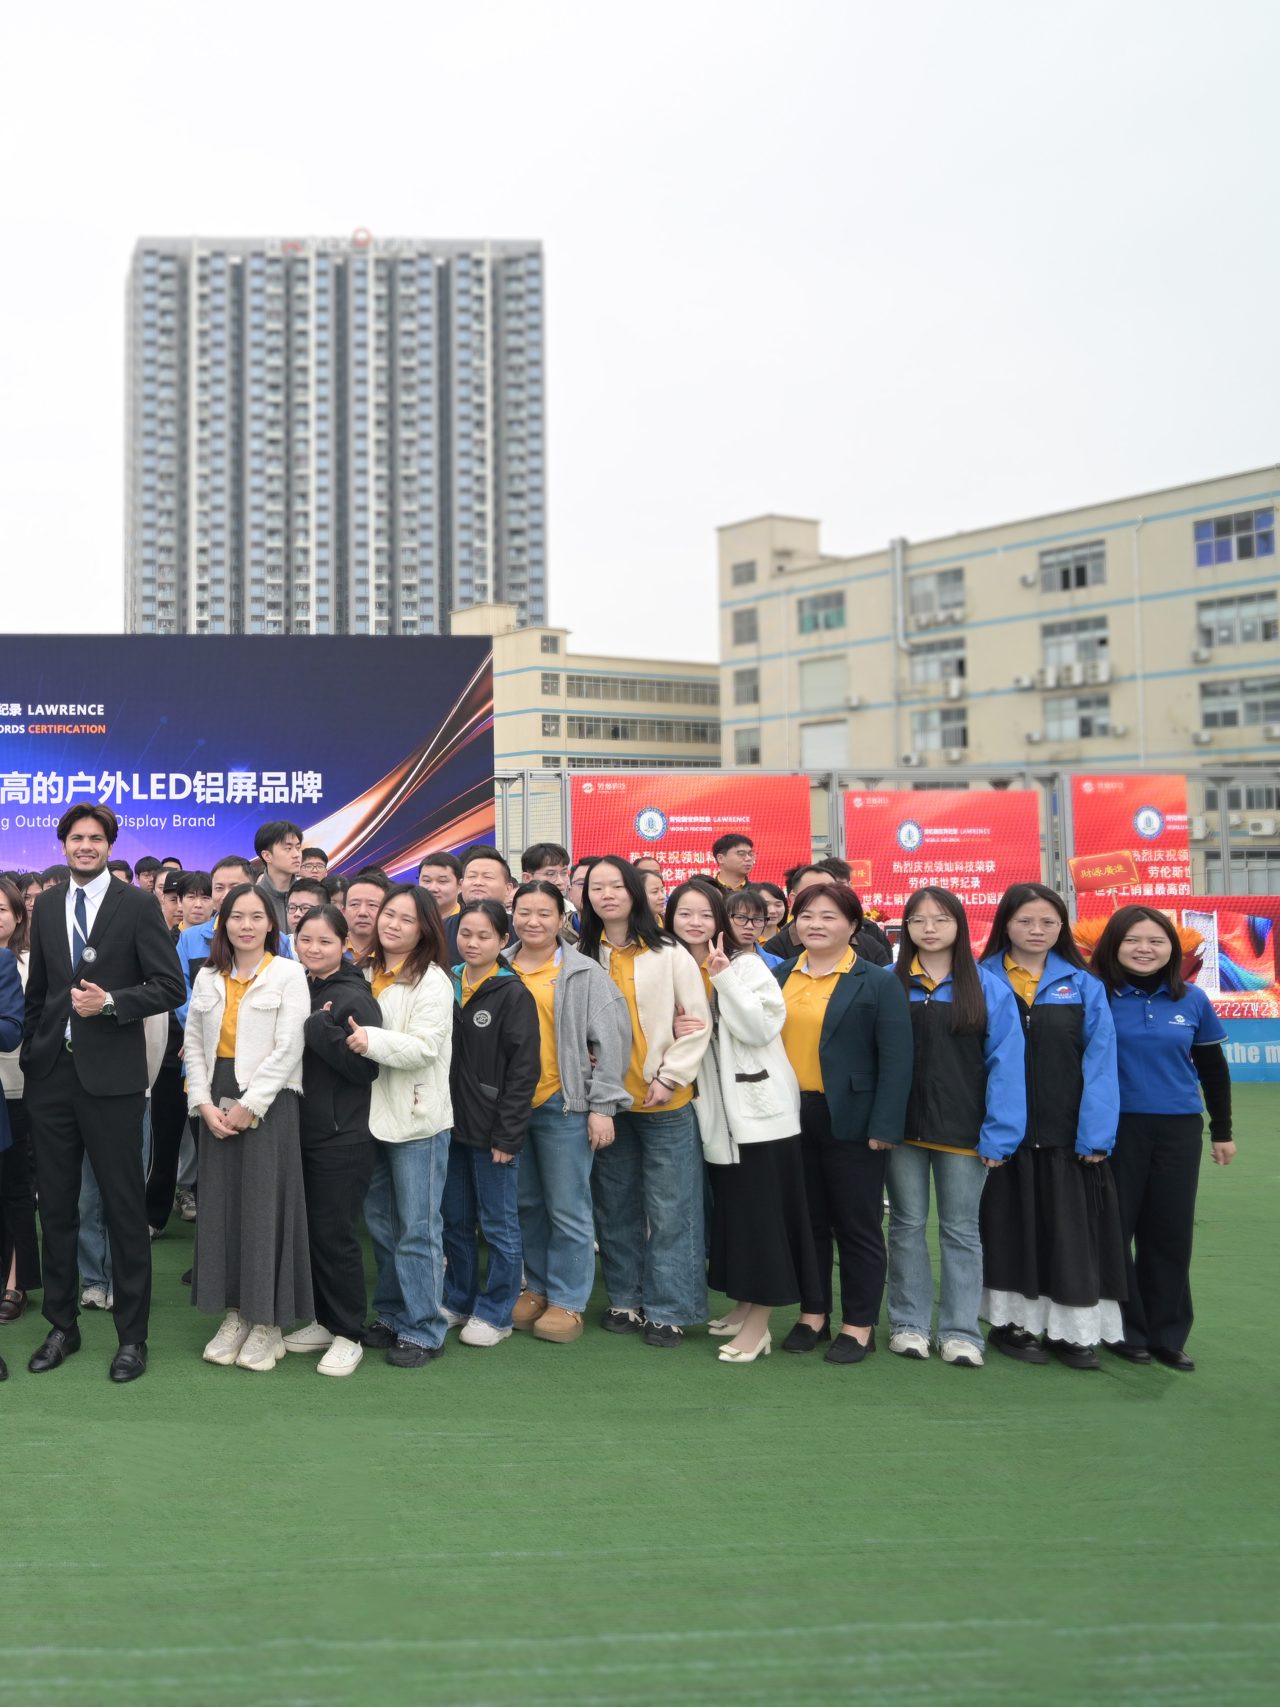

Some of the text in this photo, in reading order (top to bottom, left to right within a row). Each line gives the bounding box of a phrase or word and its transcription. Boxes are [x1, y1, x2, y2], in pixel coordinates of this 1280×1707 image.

[27, 704, 105, 716] LAWRENCE
[28, 725, 106, 734] CERTIFICATION
[15, 814, 60, 828] Outdo
[173, 814, 216, 827] Brand
[1226, 1042, 1260, 1064] the
